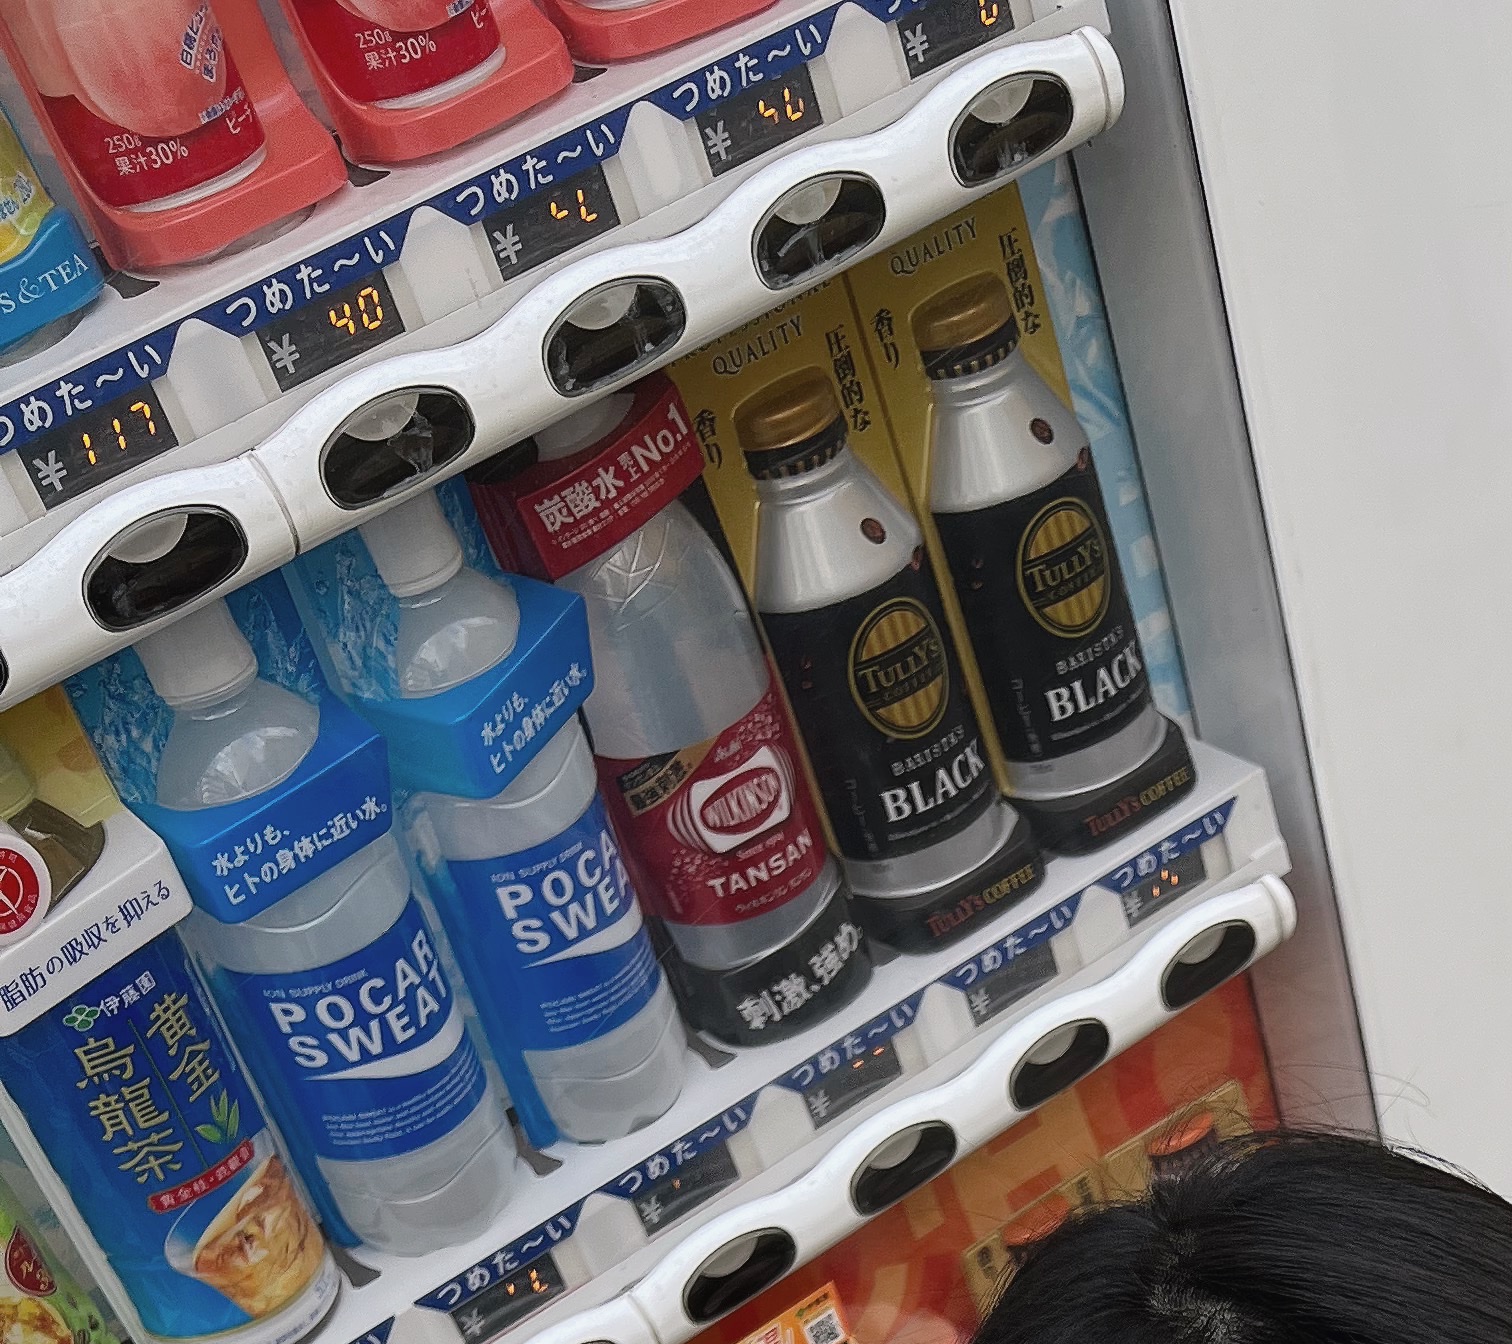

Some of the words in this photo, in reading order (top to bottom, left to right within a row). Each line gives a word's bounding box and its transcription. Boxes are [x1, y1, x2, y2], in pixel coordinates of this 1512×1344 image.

[364, 33, 437, 71] 果汁30%
[115, 138, 189, 176] 果汁30%
[891, 216, 979, 275] QUALITY
[998, 228, 1041, 335] 圧倒的な
[712, 316, 803, 376] QUALITY
[825, 325, 872, 432] 圧倒的な
[874, 308, 899, 368] 香り
[534, 465, 624, 533] 炭酸水
[631, 402, 690, 473] No.1
[694, 409, 723, 470] 香り
[1044, 640, 1142, 723] BLACK
[879, 740, 986, 823] BLACK
[224, 796, 388, 906] ヒトの身体に近い水。
[706, 829, 813, 898] TANSAN
[0, 880, 170, 1012] 脂肪の吸収を抑える
[99, 970, 156, 1016] 伊藤園
[288, 959, 447, 1068] SWEAT
[146, 991, 220, 1102] 黄金
